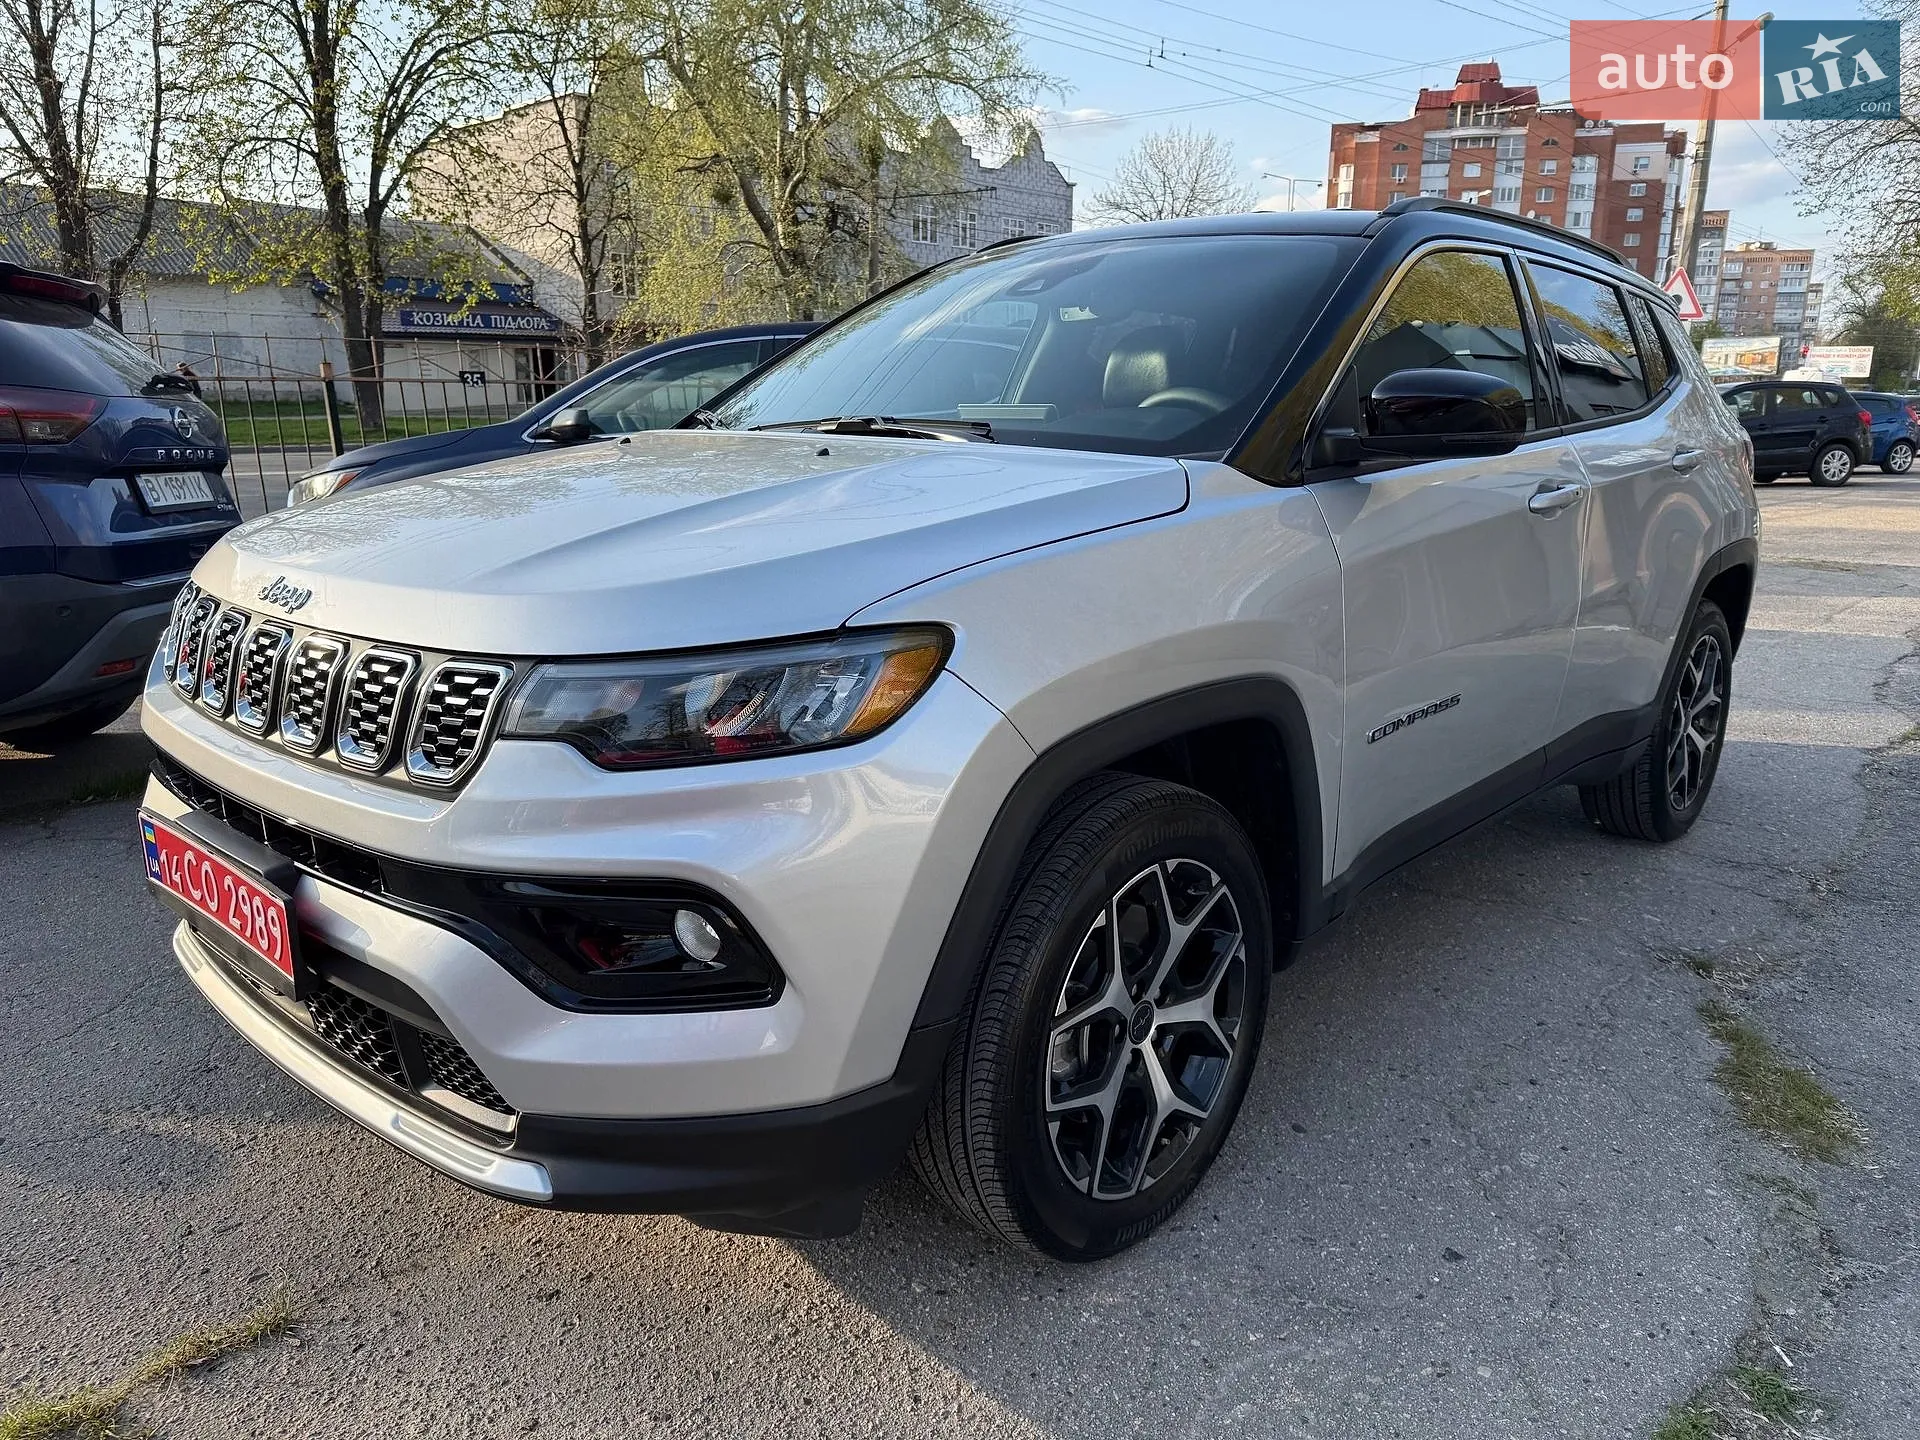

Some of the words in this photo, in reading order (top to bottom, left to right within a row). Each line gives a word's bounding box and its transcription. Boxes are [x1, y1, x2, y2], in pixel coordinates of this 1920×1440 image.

[257, 575, 313, 615] Jeep
[1366, 693, 1462, 744] COMPASS
[149, 856, 161, 875] UA
[224, 875, 282, 961] 2989
